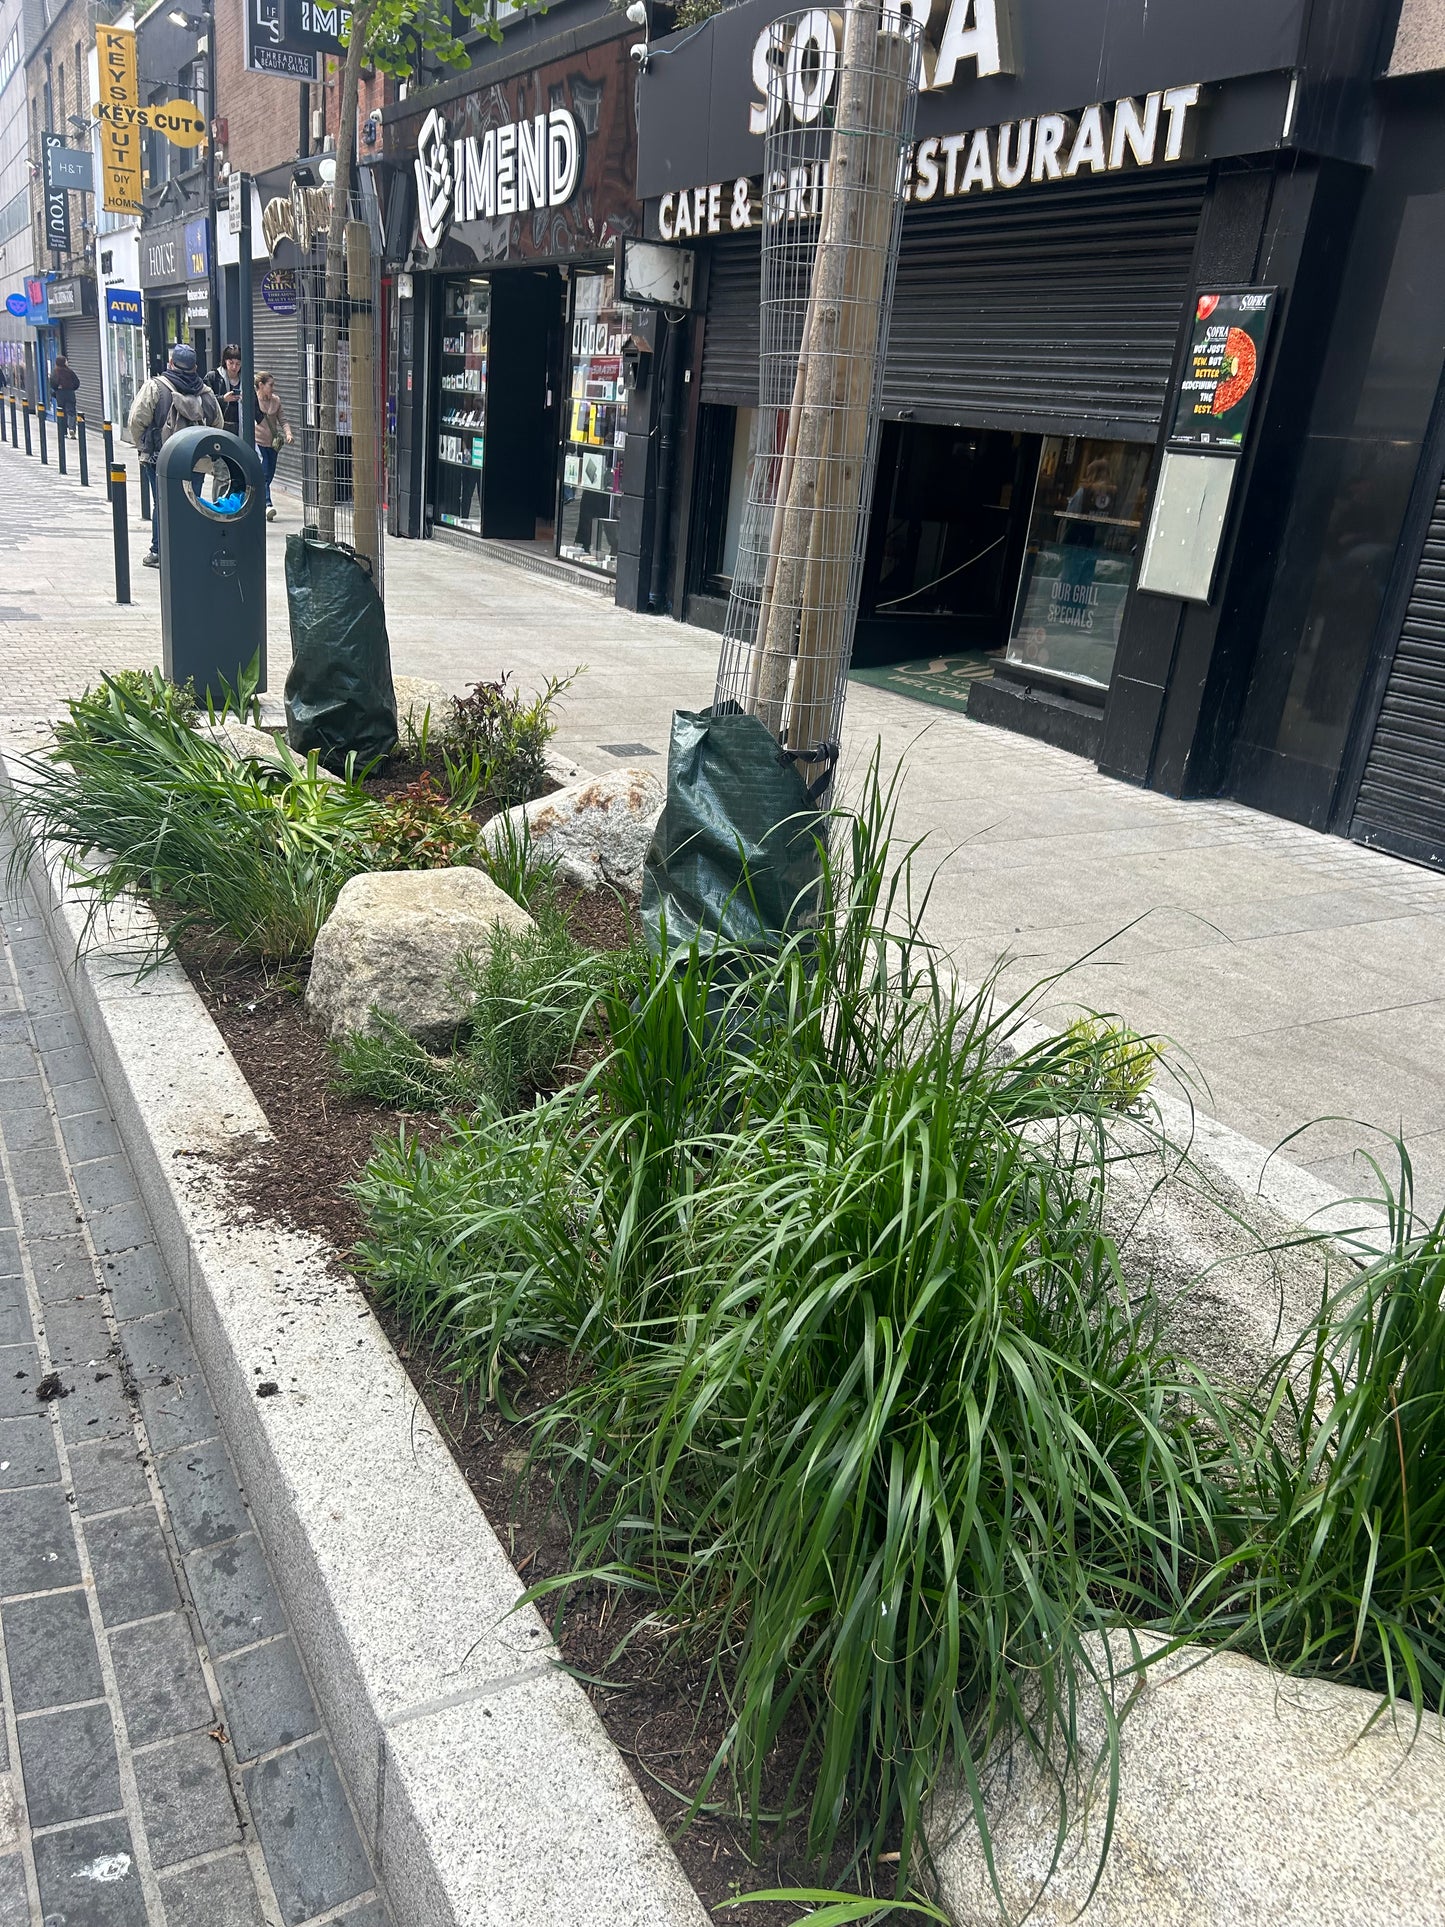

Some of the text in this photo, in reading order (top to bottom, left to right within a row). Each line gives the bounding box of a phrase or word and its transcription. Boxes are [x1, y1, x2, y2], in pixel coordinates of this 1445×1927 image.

[106, 34, 127, 100] KEYS
[260, 50, 309, 67] THREADING
[260, 57, 309, 74] BEAUTY SALON
[749, 0, 1002, 135] SORA
[99, 103, 193, 133] KEYS CUT
[59, 162, 84, 175] H&T
[453, 108, 580, 223] IMEND
[113, 174, 130, 185] DIY
[118, 187, 126, 196] &
[49, 192, 65, 233] YOU
[658, 184, 722, 240] CAFE
[730, 177, 752, 230] &
[148, 242, 176, 277] HOUSE
[111, 300, 138, 313] ATM
[1239, 294, 1267, 312] SOFRA
[1204, 326, 1230, 342] SOFRA
[1051, 581, 1099, 606] OUR GRILL
[1047, 603, 1094, 629] SPECIALS
[887, 675, 969, 702] WELCOM
